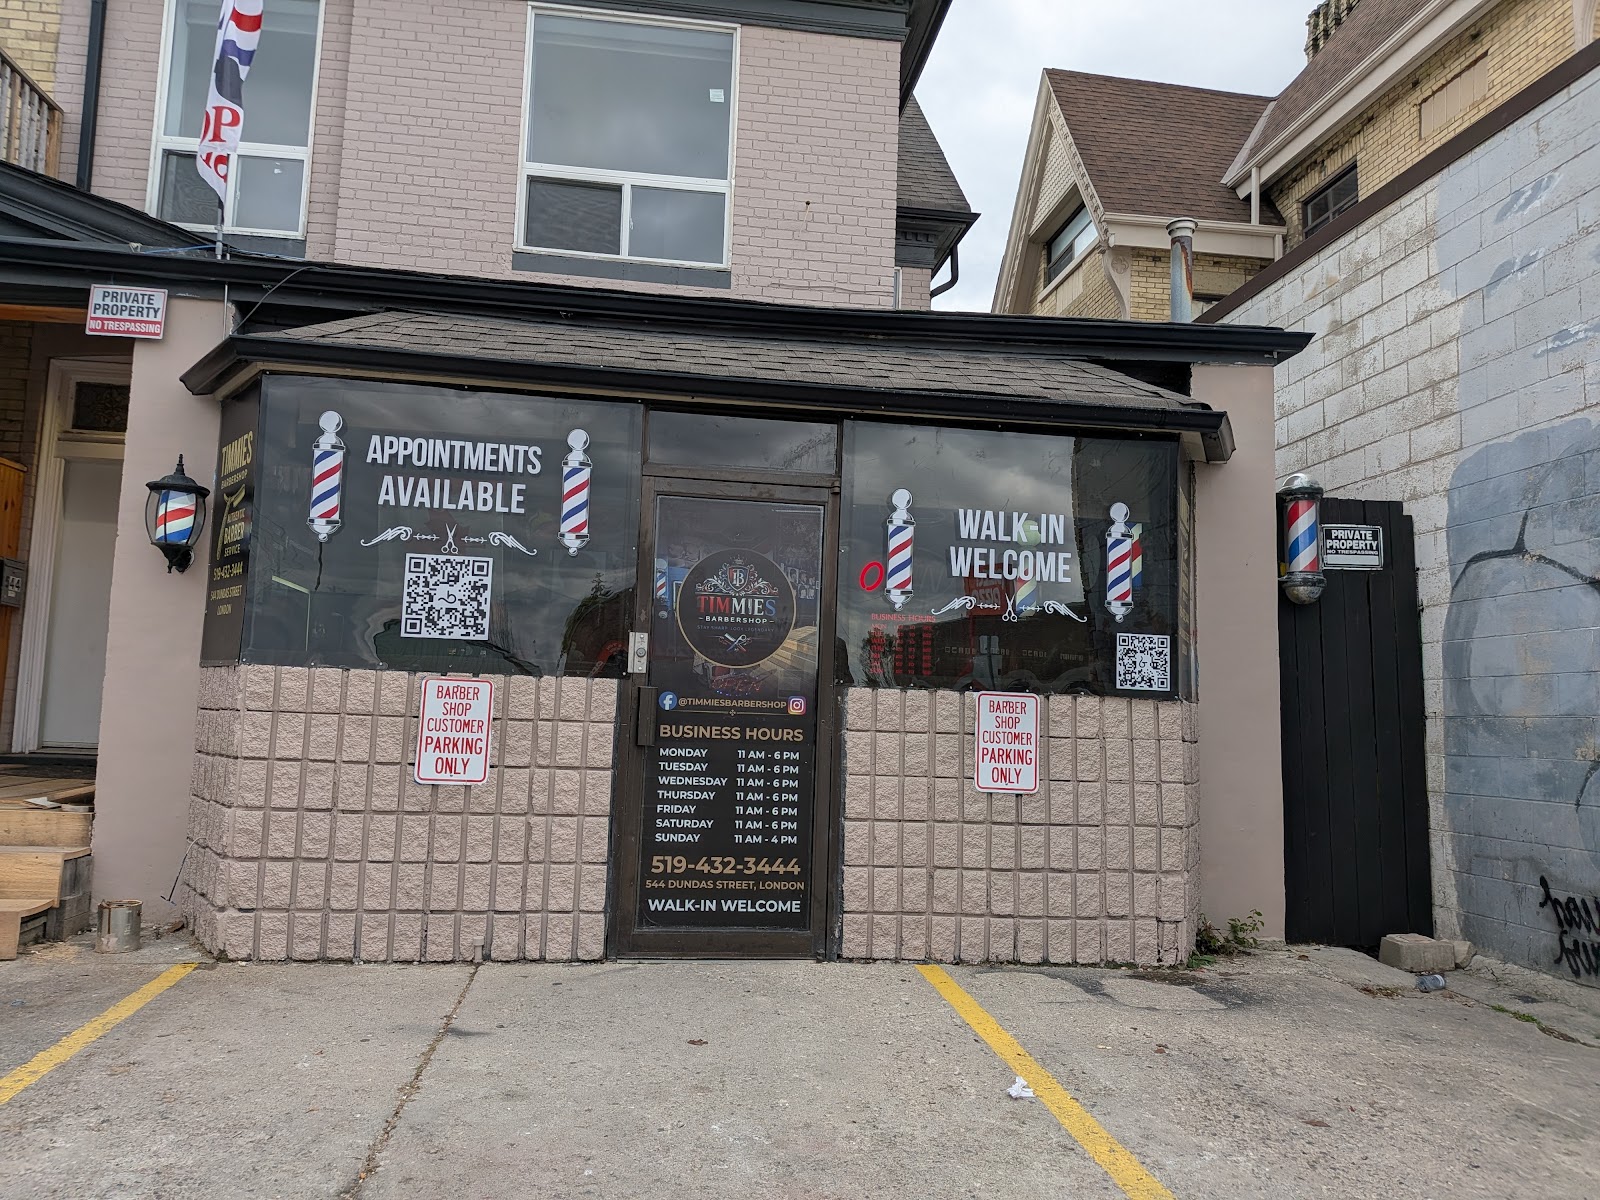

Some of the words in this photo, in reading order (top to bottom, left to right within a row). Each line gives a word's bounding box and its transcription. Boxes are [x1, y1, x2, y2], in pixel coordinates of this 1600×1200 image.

[102, 290, 155, 306] PRIVATE
[93, 303, 160, 318] PROPERTY
[90, 320, 102, 329] NO
[103, 321, 160, 333] TRESPASSING
[221, 430, 253, 478] TIMMIES
[366, 434, 542, 475] APPOINTMENTS
[221, 468, 248, 490] BARBERSHOP
[378, 475, 526, 514] AVAILABLE
[224, 522, 245, 545] BARBER
[958, 508, 1064, 545] WALK-IN
[1331, 530, 1372, 540] PRIVATE
[224, 544, 240, 558] SERVICE
[1326, 540, 1378, 550] PROPERTY
[950, 546, 1071, 582] WELCOME
[697, 596, 776, 616] TIMMIES
[705, 616, 768, 624] BARBERSHOP
[871, 613, 906, 622] BUSINESS
[436, 685, 480, 700] BARBER
[442, 702, 472, 716] SHOP
[678, 698, 787, 709] @TIMMIESBARBERSHOP
[989, 700, 1026, 714] BARBER
[427, 718, 484, 733] CUSTOMER
[995, 716, 1020, 729] SHOP
[660, 724, 741, 740] BUSINESS
[746, 728, 804, 742] HOURS
[982, 730, 1032, 746] CUSTOMER
[424, 736, 483, 755] PARKING
[660, 748, 708, 757] MONDAY
[738, 750, 745, 758] 11
[748, 750, 765, 759] AM
[774, 751, 780, 759] 6
[783, 752, 799, 760] PM
[982, 748, 1032, 765] PARKING
[435, 757, 470, 774] ONLY
[659, 762, 708, 771] TUESDAY
[737, 764, 744, 772] 11
[747, 764, 764, 773] AM
[774, 765, 780, 773] 6
[783, 766, 798, 774] PM
[658, 776, 728, 786] WEDNESDAY
[736, 778, 744, 787] 11
[747, 779, 764, 787] AM
[773, 779, 779, 787] 6
[782, 780, 798, 788] PM
[992, 767, 1022, 784] ONLY
[657, 790, 716, 800] THURSDAY
[736, 792, 744, 800] 11
[746, 792, 763, 801] AM
[772, 793, 779, 801] 6
[782, 794, 798, 802] PM
[656, 805, 696, 814] FRIDAY
[736, 806, 743, 815] 11
[746, 807, 762, 815] AM
[772, 807, 778, 815] 6
[781, 808, 797, 816] PM
[656, 819, 714, 828] SATURDAY
[735, 820, 742, 829] 11
[745, 821, 762, 829] AM
[772, 822, 778, 830] 6
[781, 822, 797, 830] PM
[655, 833, 700, 842] SUNDAY
[734, 835, 742, 843] 11
[745, 835, 762, 844] AM
[771, 836, 778, 844] 4
[781, 836, 797, 844] PM
[651, 856, 800, 874] 519-432-3444
[645, 880, 666, 888] 544
[668, 880, 713, 889] DUNDAS
[716, 881, 757, 891] STREET,
[759, 881, 804, 890] LONDON
[648, 899, 716, 912] WALK-IN
[721, 900, 800, 912] WELCOME
